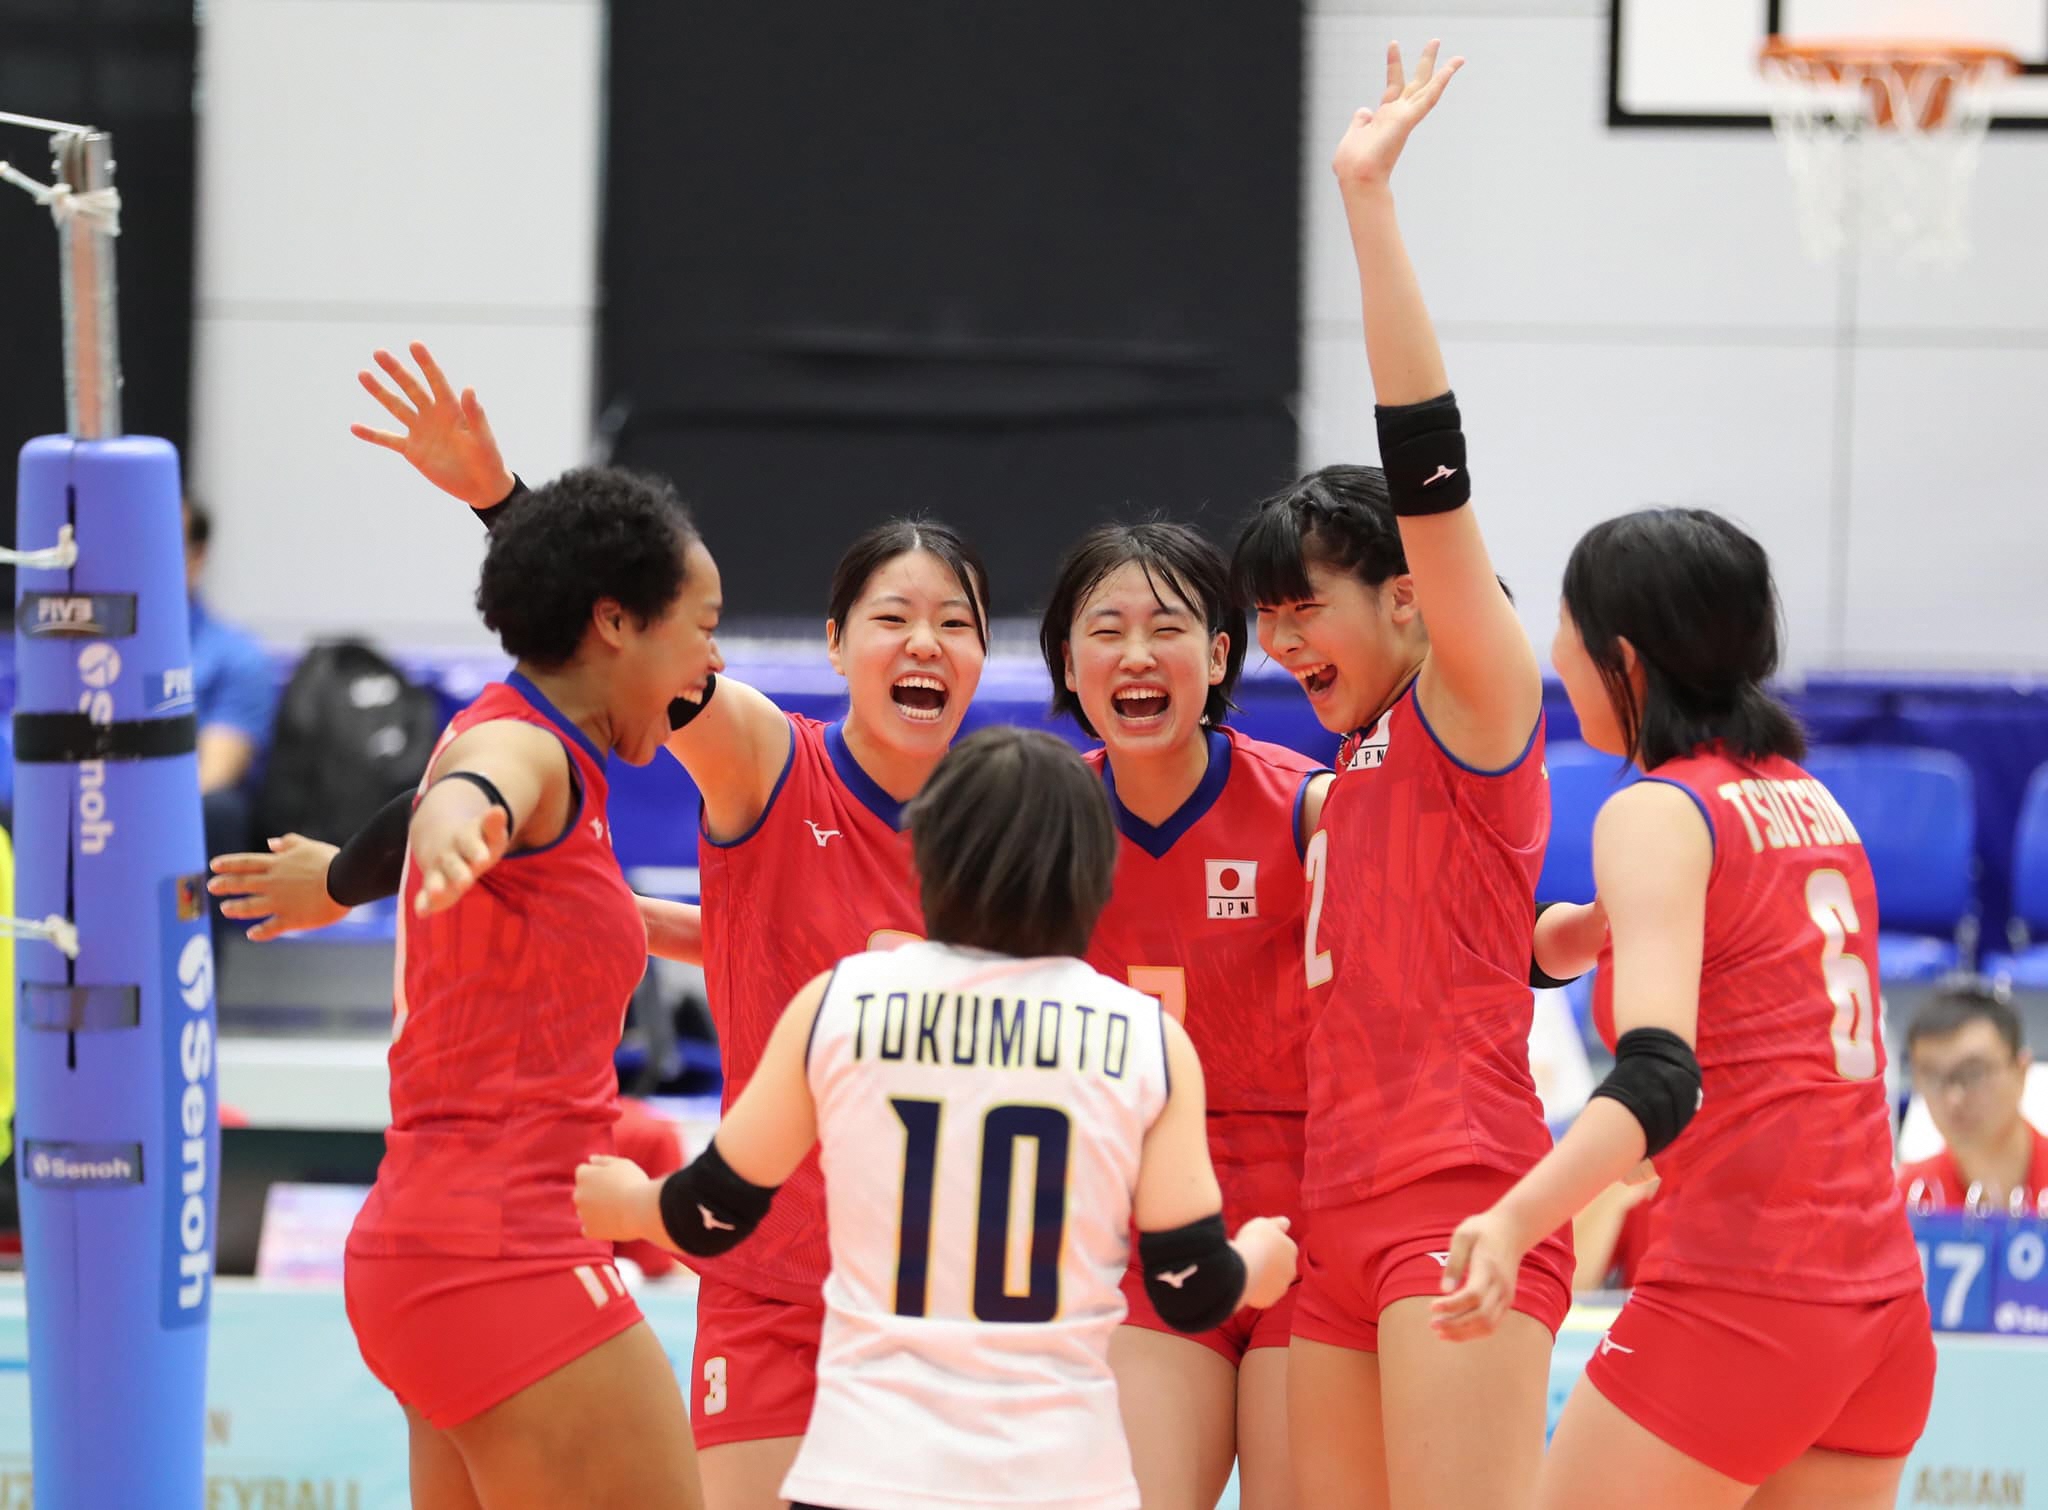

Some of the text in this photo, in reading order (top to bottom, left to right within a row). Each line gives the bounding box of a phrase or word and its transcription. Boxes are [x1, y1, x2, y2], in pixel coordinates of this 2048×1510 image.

[37, 597, 95, 623] FIVB
[79, 690, 116, 854] Snoh
[1351, 750, 1386, 768] JPN
[1216, 901, 1250, 917] JPN
[1805, 867, 1878, 1082] 6
[854, 992, 1129, 1080] TOKUMOTO
[53, 1158, 131, 1179] Senoh
[178, 1018, 212, 1310] Senoh
[887, 1096, 1072, 1324] 10
[703, 1356, 728, 1416] 3
[206, 1474, 360, 1510] EYBALL
[1913, 1465, 2024, 1506] ASIAN
